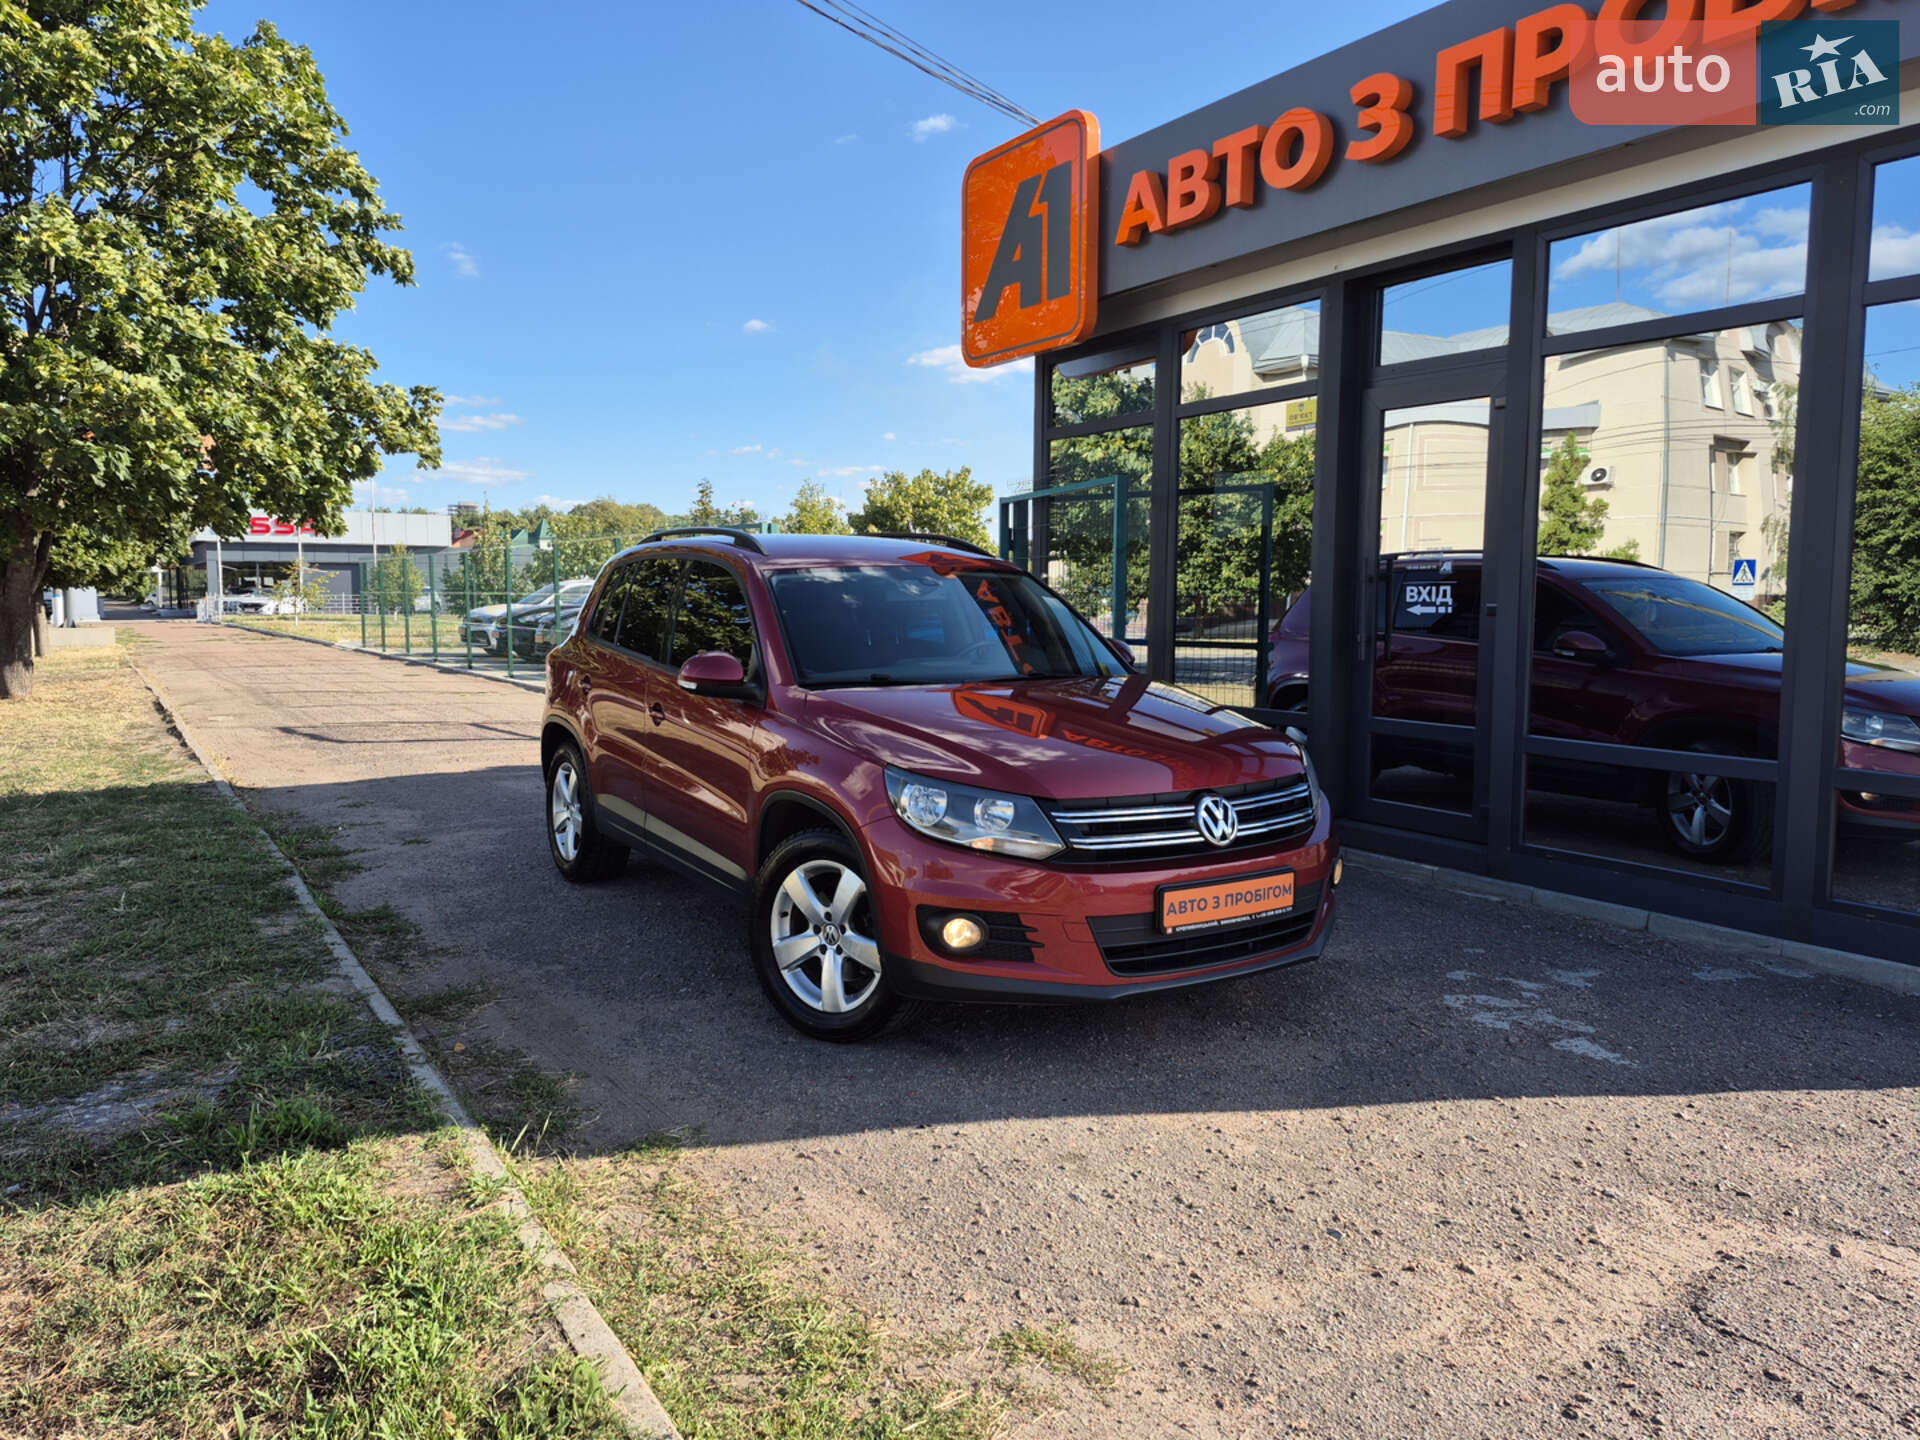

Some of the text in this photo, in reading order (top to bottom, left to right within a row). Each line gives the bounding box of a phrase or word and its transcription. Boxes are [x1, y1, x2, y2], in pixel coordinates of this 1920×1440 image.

[1115, 107, 1334, 248] АВТО
[1345, 72, 1414, 163] З
[1406, 585, 1453, 605] ВХІД
[1166, 883, 1292, 916] АВТО З ПРОБІГОМ
